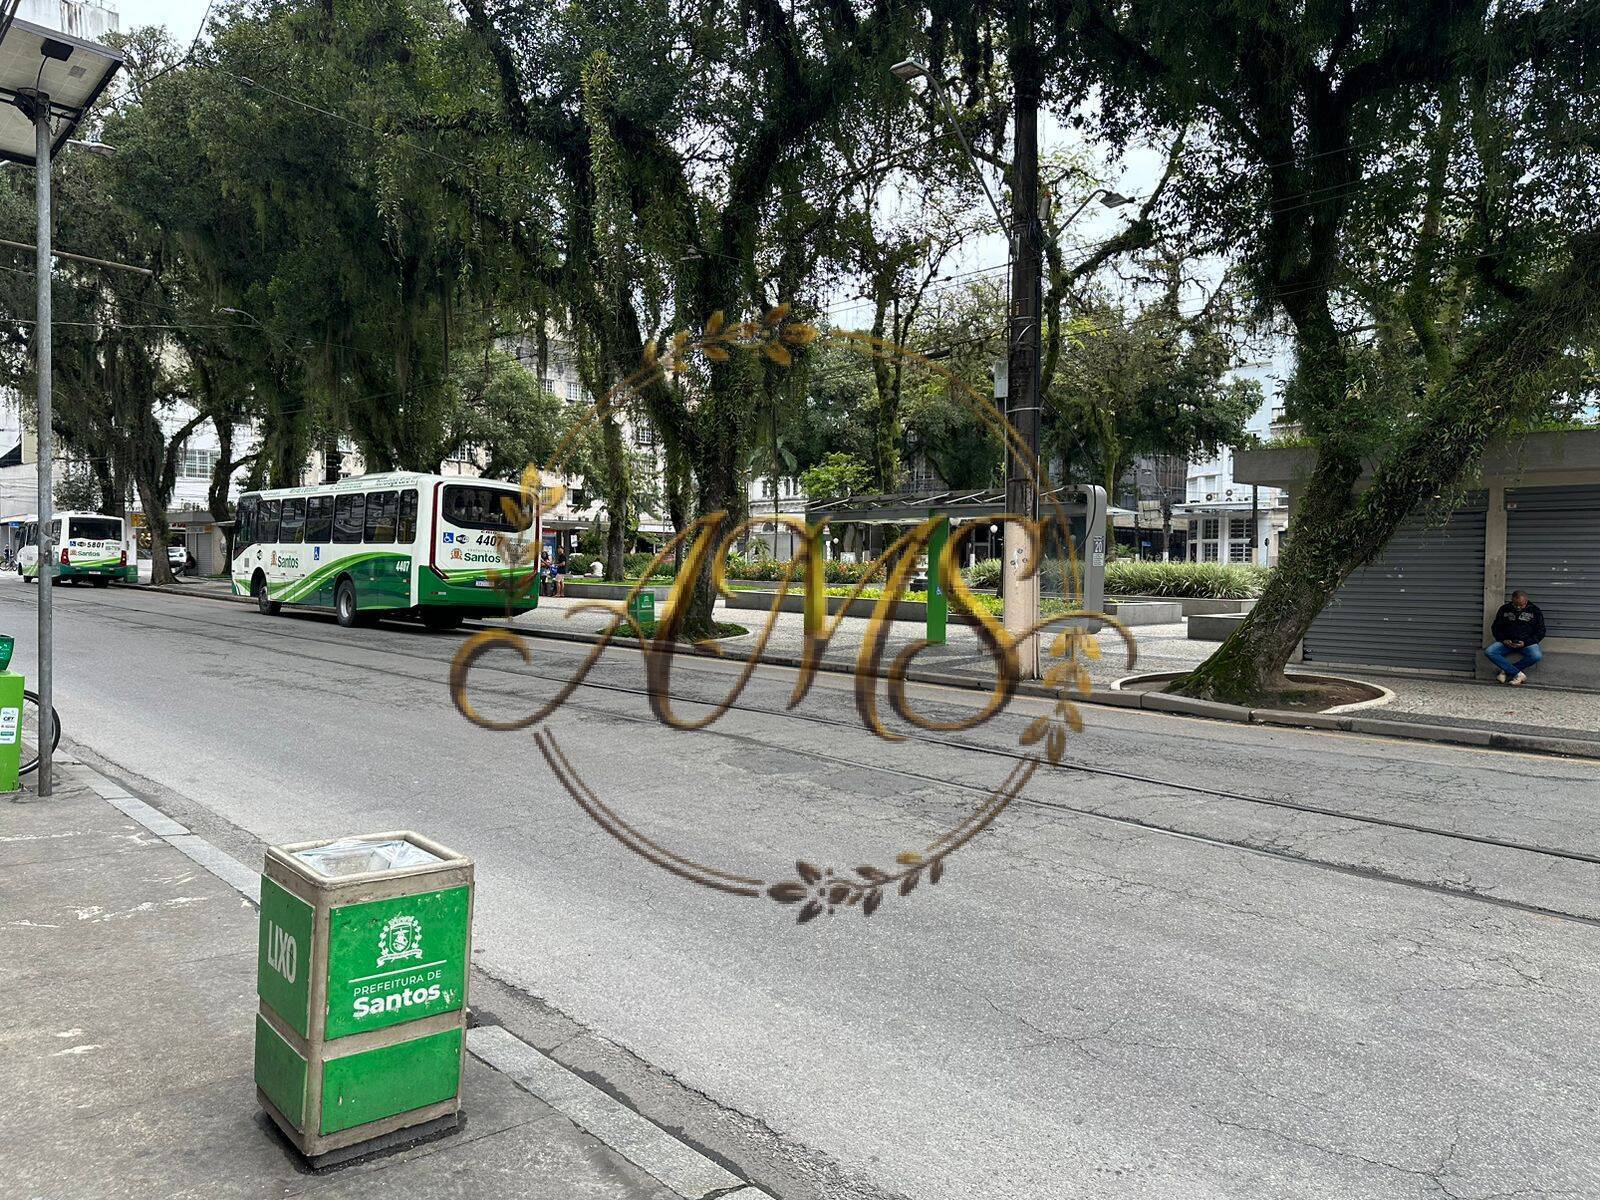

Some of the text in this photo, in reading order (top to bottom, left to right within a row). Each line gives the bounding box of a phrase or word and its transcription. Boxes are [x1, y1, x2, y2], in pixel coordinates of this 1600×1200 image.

[87, 541, 105, 549] 5801
[476, 534, 504, 547] 4407
[1094, 541, 1102, 552] 20
[277, 555, 299, 569] Santos
[464, 552, 501, 563] Santos
[395, 560, 410, 572] 4407
[267, 920, 297, 984] LIXO
[353, 969, 442, 997] PREFEITURA DE
[353, 984, 441, 1018] Santos
